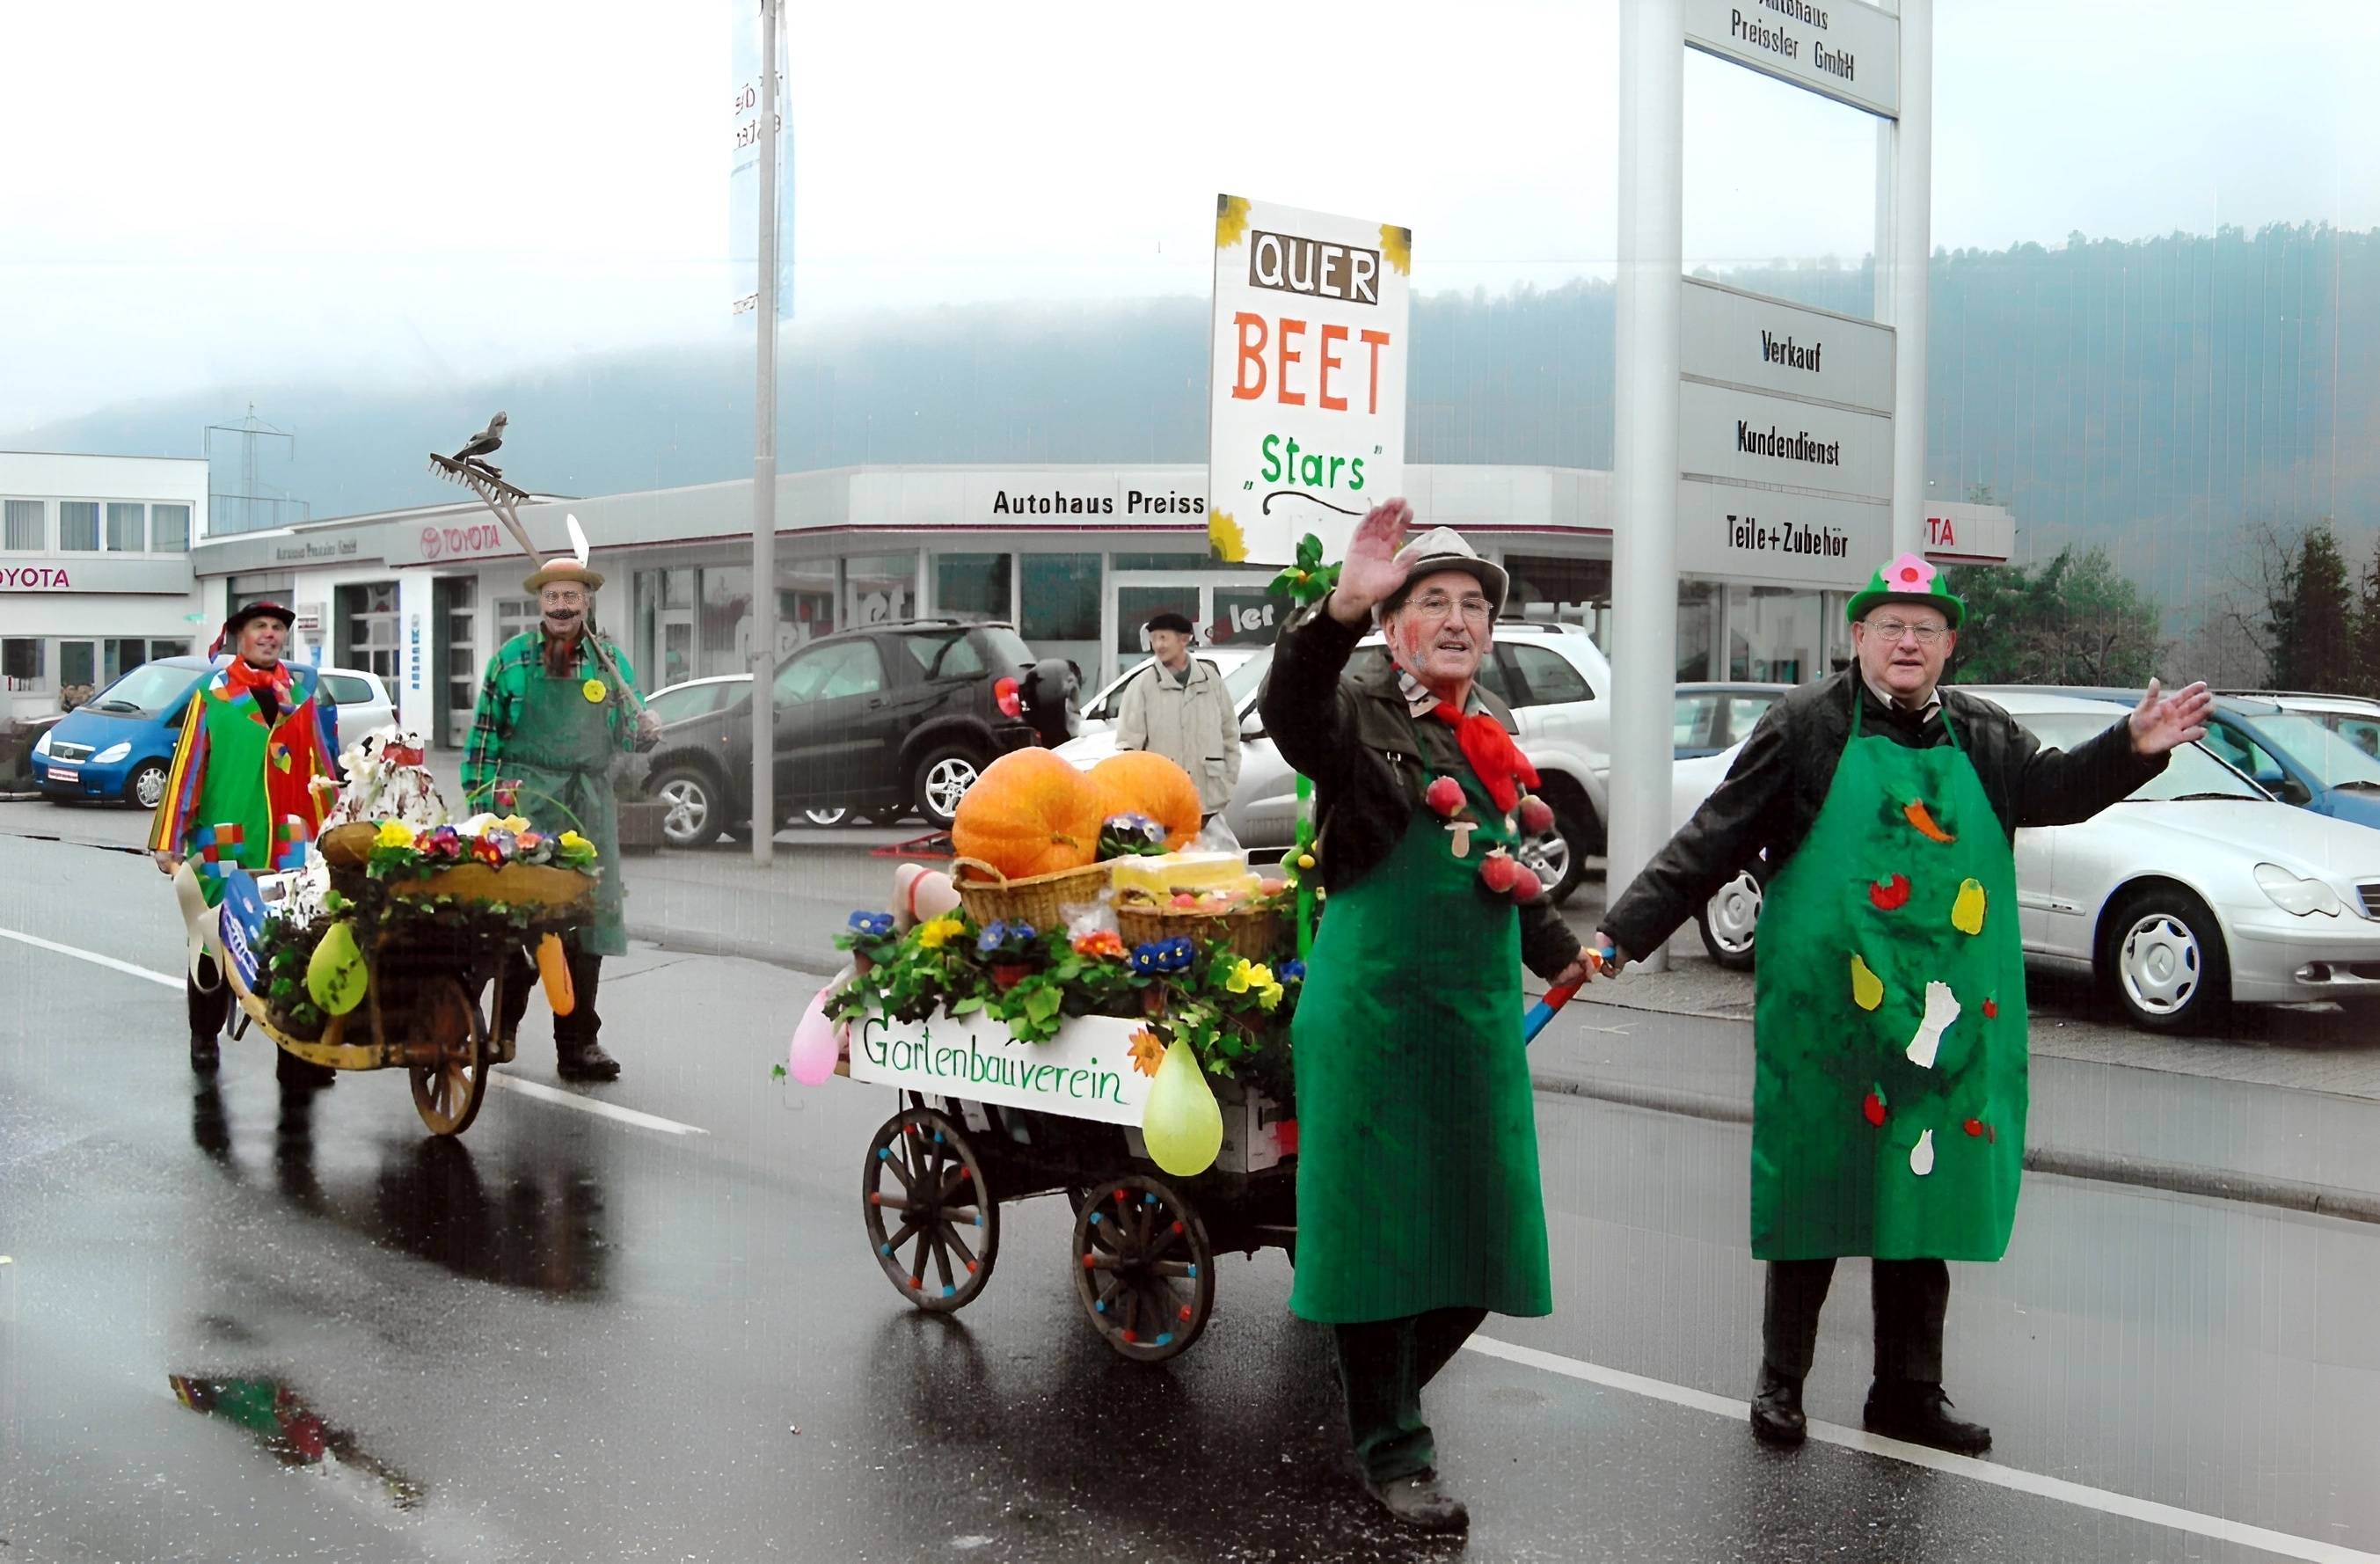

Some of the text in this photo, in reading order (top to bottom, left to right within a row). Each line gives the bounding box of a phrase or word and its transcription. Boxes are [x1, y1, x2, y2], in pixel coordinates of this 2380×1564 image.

[1759, 0, 1829, 30] utohaus
[1732, 8, 1854, 81] Preissler GmbH
[1255, 234, 1377, 303] QUER
[1231, 311, 1391, 414] BEET
[1762, 330, 1822, 373] Verkauf
[1738, 420, 1839, 466] Kundendienst
[993, 490, 1205, 515] Autohaus Preiss
[442, 524, 500, 553] TOYOTA
[1727, 515, 1848, 558] Teile+Zubehör
[1924, 517, 1954, 546] TA
[0, 568, 69, 588] YOTA
[863, 1017, 1131, 1106] Gartenbauverein
